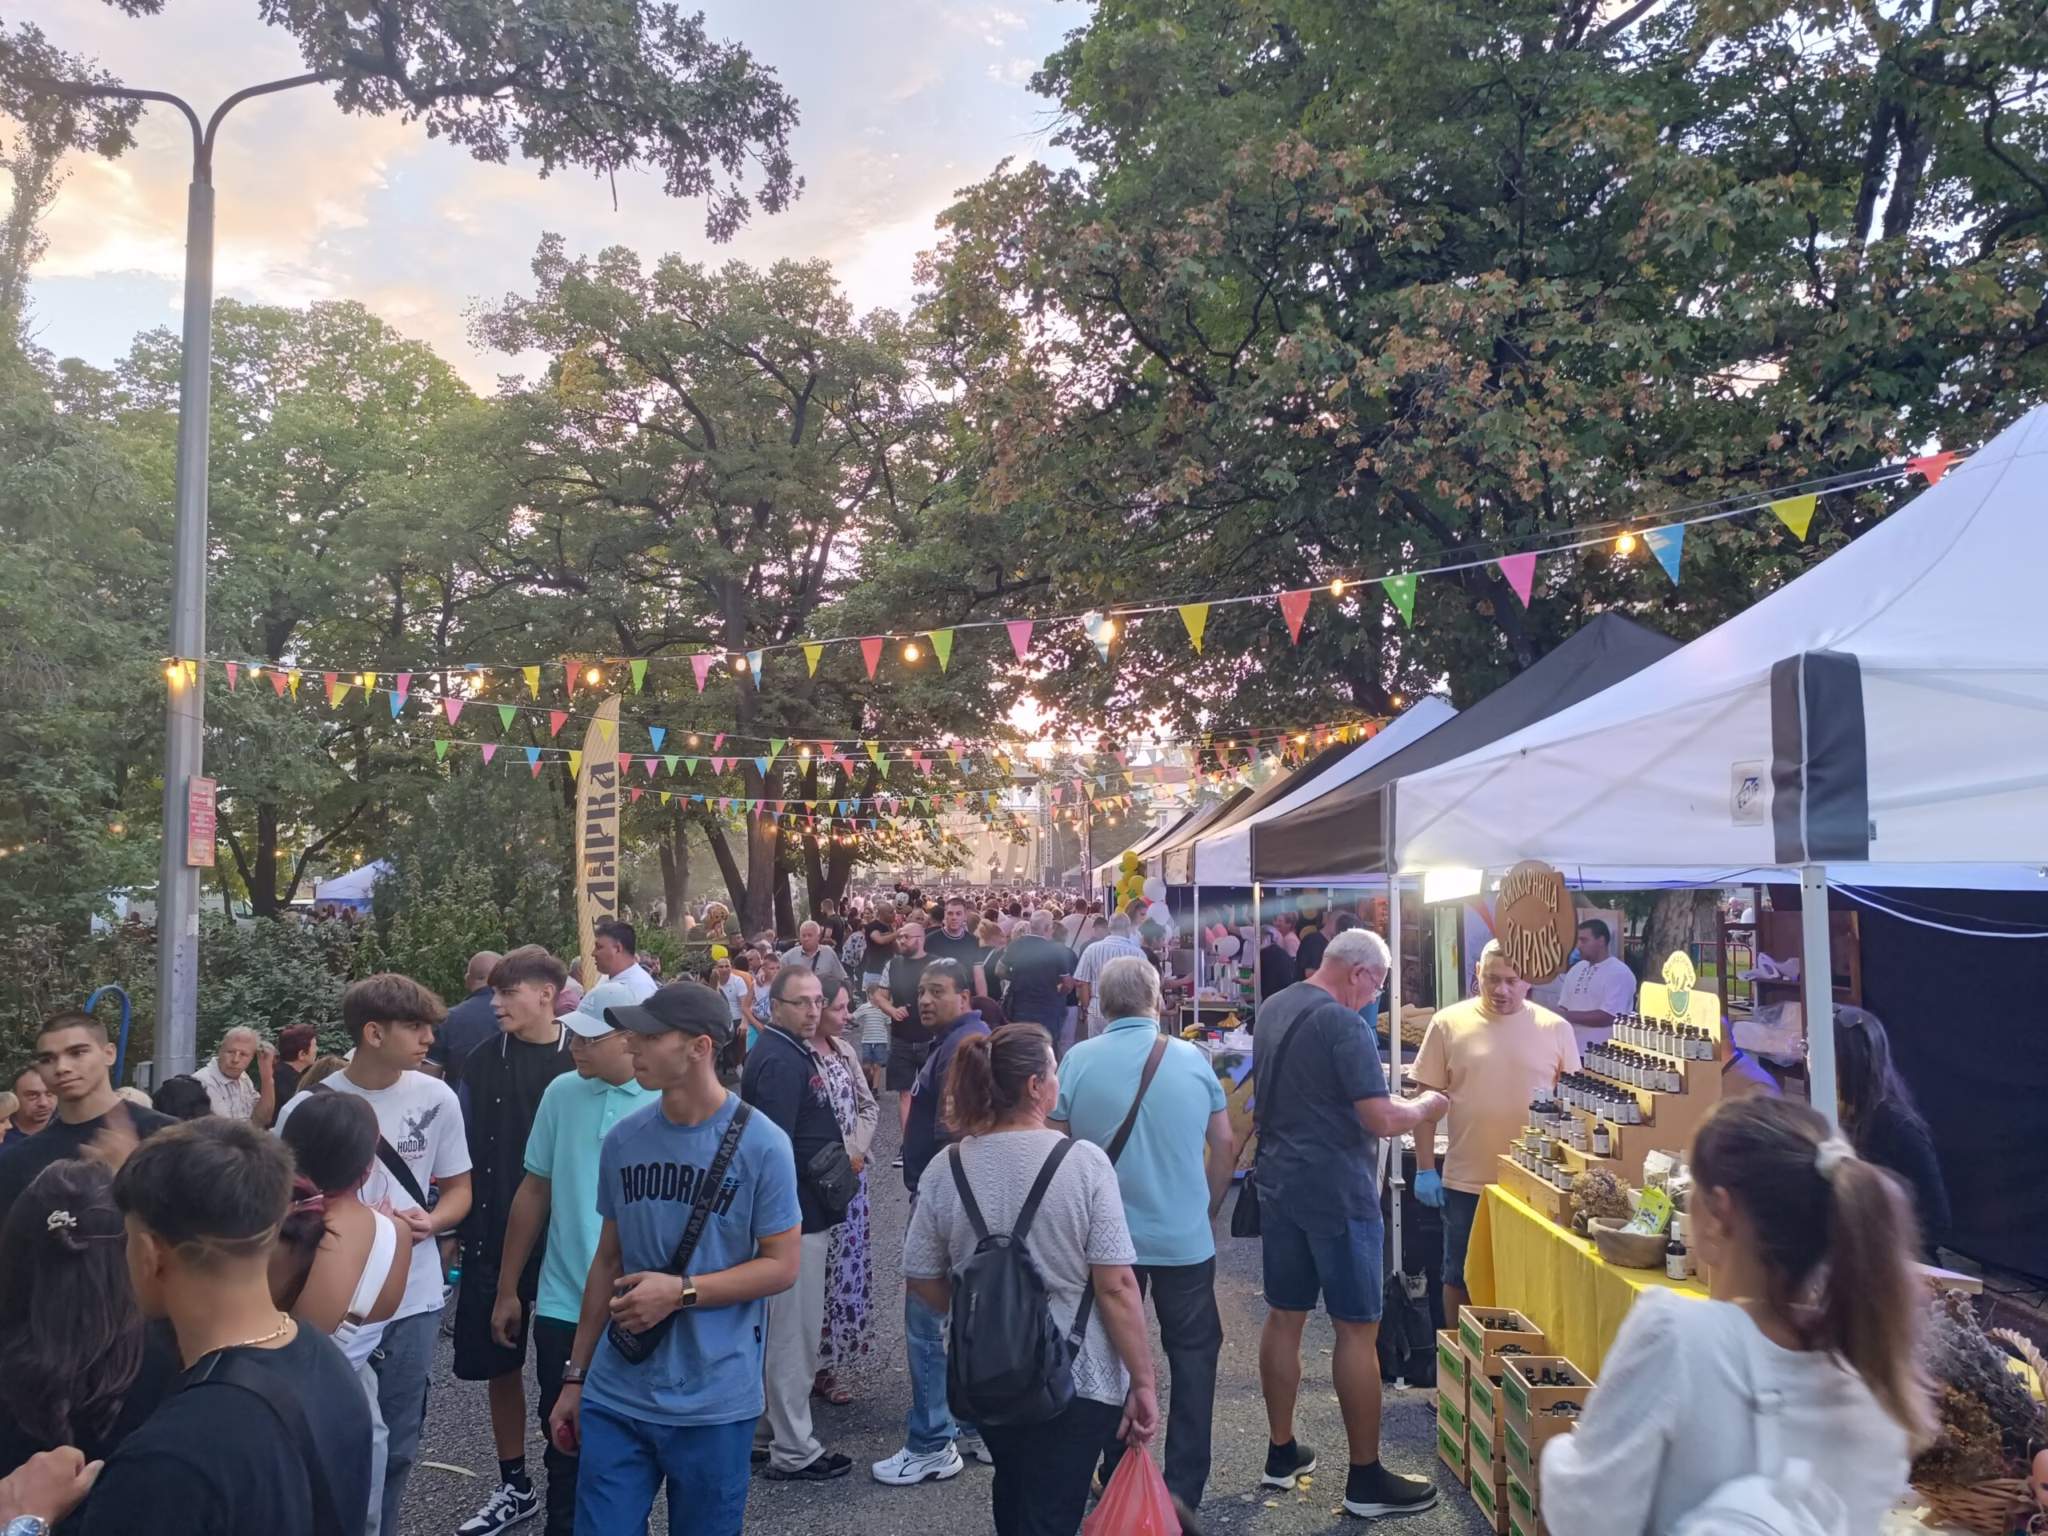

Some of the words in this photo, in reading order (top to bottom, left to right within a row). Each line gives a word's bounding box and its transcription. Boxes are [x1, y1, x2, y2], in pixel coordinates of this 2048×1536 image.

[1502, 869, 1558, 912] БИЛКАРНИЦА
[1505, 917, 1561, 977] ЗДРАВЕ
[620, 1162, 739, 1216] HOODRIH
